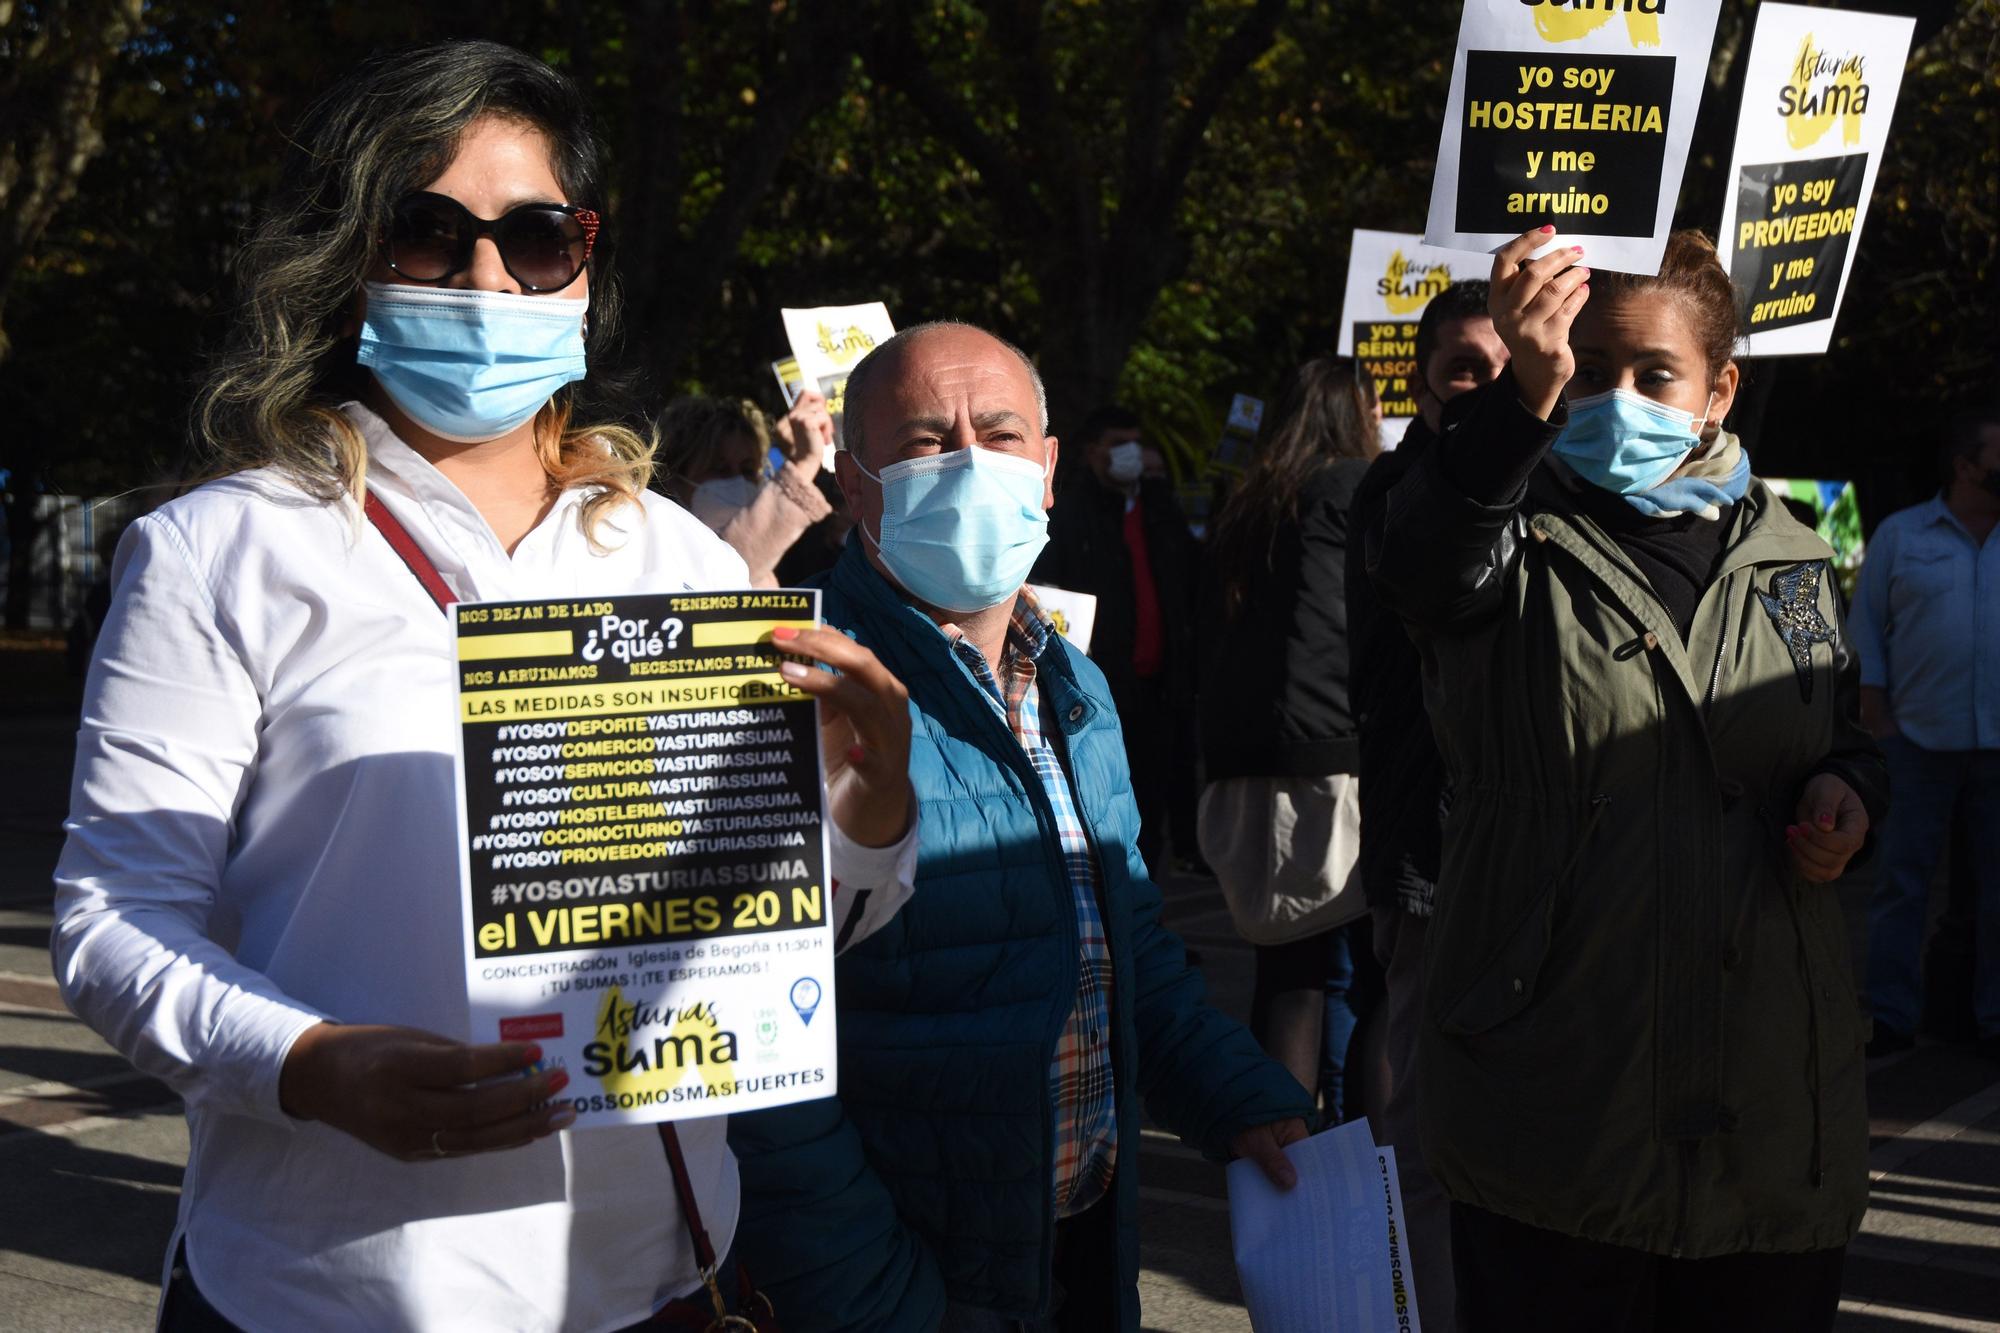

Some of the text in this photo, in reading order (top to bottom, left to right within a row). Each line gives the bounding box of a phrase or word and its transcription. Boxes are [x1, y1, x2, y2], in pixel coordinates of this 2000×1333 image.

[1791, 43, 1867, 84] Asturias
[1518, 66, 1615, 96] yo soy
[1469, 100, 1663, 133] HOSTELERIA
[1777, 83, 1870, 117] suma
[1526, 150, 1596, 179] y me
[1507, 186, 1609, 215] arruino
[1772, 178, 1836, 213] yo soy
[1739, 207, 1857, 250] PROVEEDOR
[1377, 277, 1441, 297] sum
[1769, 257, 1815, 290] y me
[1751, 291, 1816, 324] arruino
[1357, 341, 1415, 357] SERVI
[1370, 324, 1396, 340] yo
[459, 602, 614, 624] NOS DEJAN DE LADO
[670, 595, 808, 611] TENEMOS FAMILIA
[464, 664, 598, 685] NOS ARRUINAMOS
[630, 656, 733, 676] NECESITAMOS
[468, 700, 506, 716] LAS
[515, 693, 604, 713] MEDIDAS
[613, 691, 653, 707] SON
[497, 707, 786, 741] #YOSOYDEPORTEYASTURIASSUMA
[492, 727, 793, 763] #YOSOYCOMERCIOYASTURIASSUMA
[495, 749, 792, 784] #YOSOYSERVICIOSYASTURIASSUMA
[503, 771, 788, 806] #YOSOYCULTURAYASTURIASSUMA
[490, 792, 802, 829] #YOSOYHOSTELERIAYASTURIASSUMA
[472, 810, 820, 850] #YOSOYOCIONOCTURNOYASTURIASSUMA
[492, 831, 805, 870] #YOSOYPROVEEDORYASTURIASSUMA
[491, 859, 809, 905] #YOSOYASTURIASSUMA
[478, 886, 822, 951] el VIERNES 20 N
[482, 938, 823, 980] CONCENTRACIÓN Iglesia de Begoña 11:30 H
[552, 979, 570, 992] TU
[575, 974, 629, 991] SUMAS
[669, 962, 761, 982] ESPERAMOS
[597, 998, 720, 1042] Asturias
[583, 1029, 738, 1078] suma
